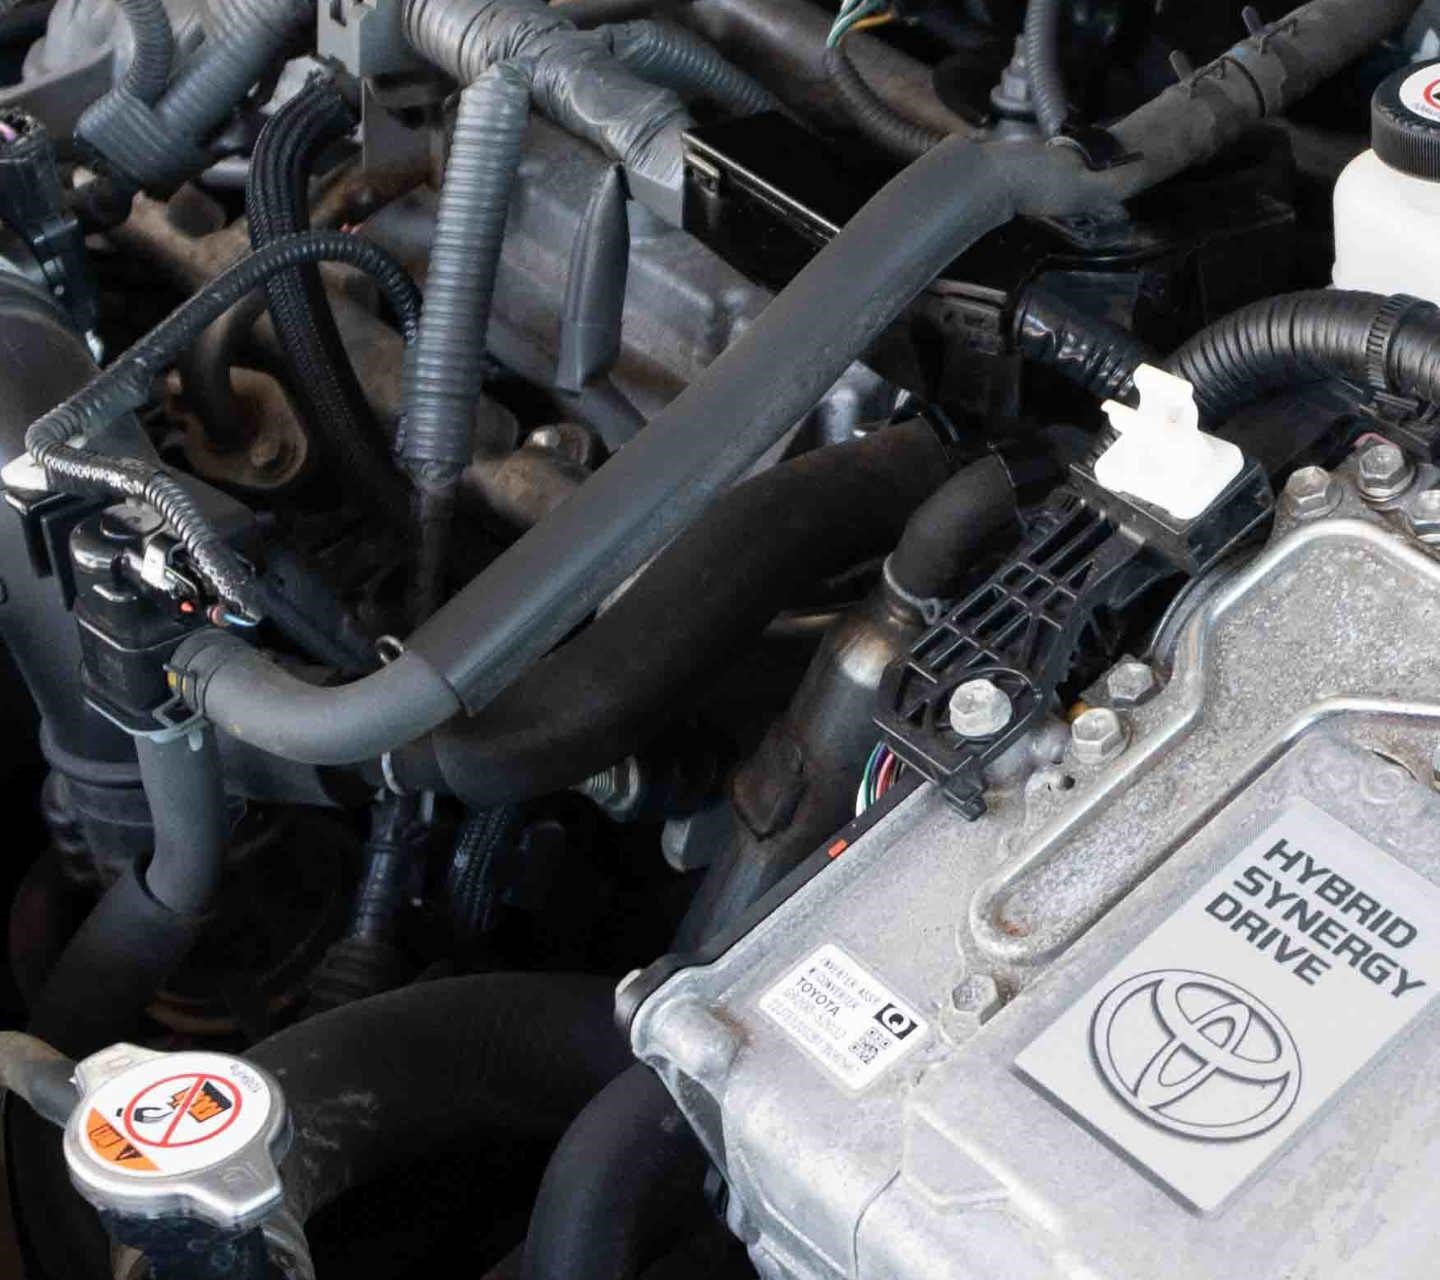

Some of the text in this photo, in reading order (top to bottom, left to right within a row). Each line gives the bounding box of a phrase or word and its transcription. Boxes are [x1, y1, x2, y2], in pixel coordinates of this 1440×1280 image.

[1204, 893, 1332, 986] DRIVE
[1233, 866, 1427, 998] SYNERGY
[1263, 838, 1418, 950] HYBRID
[796, 977, 841, 1016] TOYOTA
